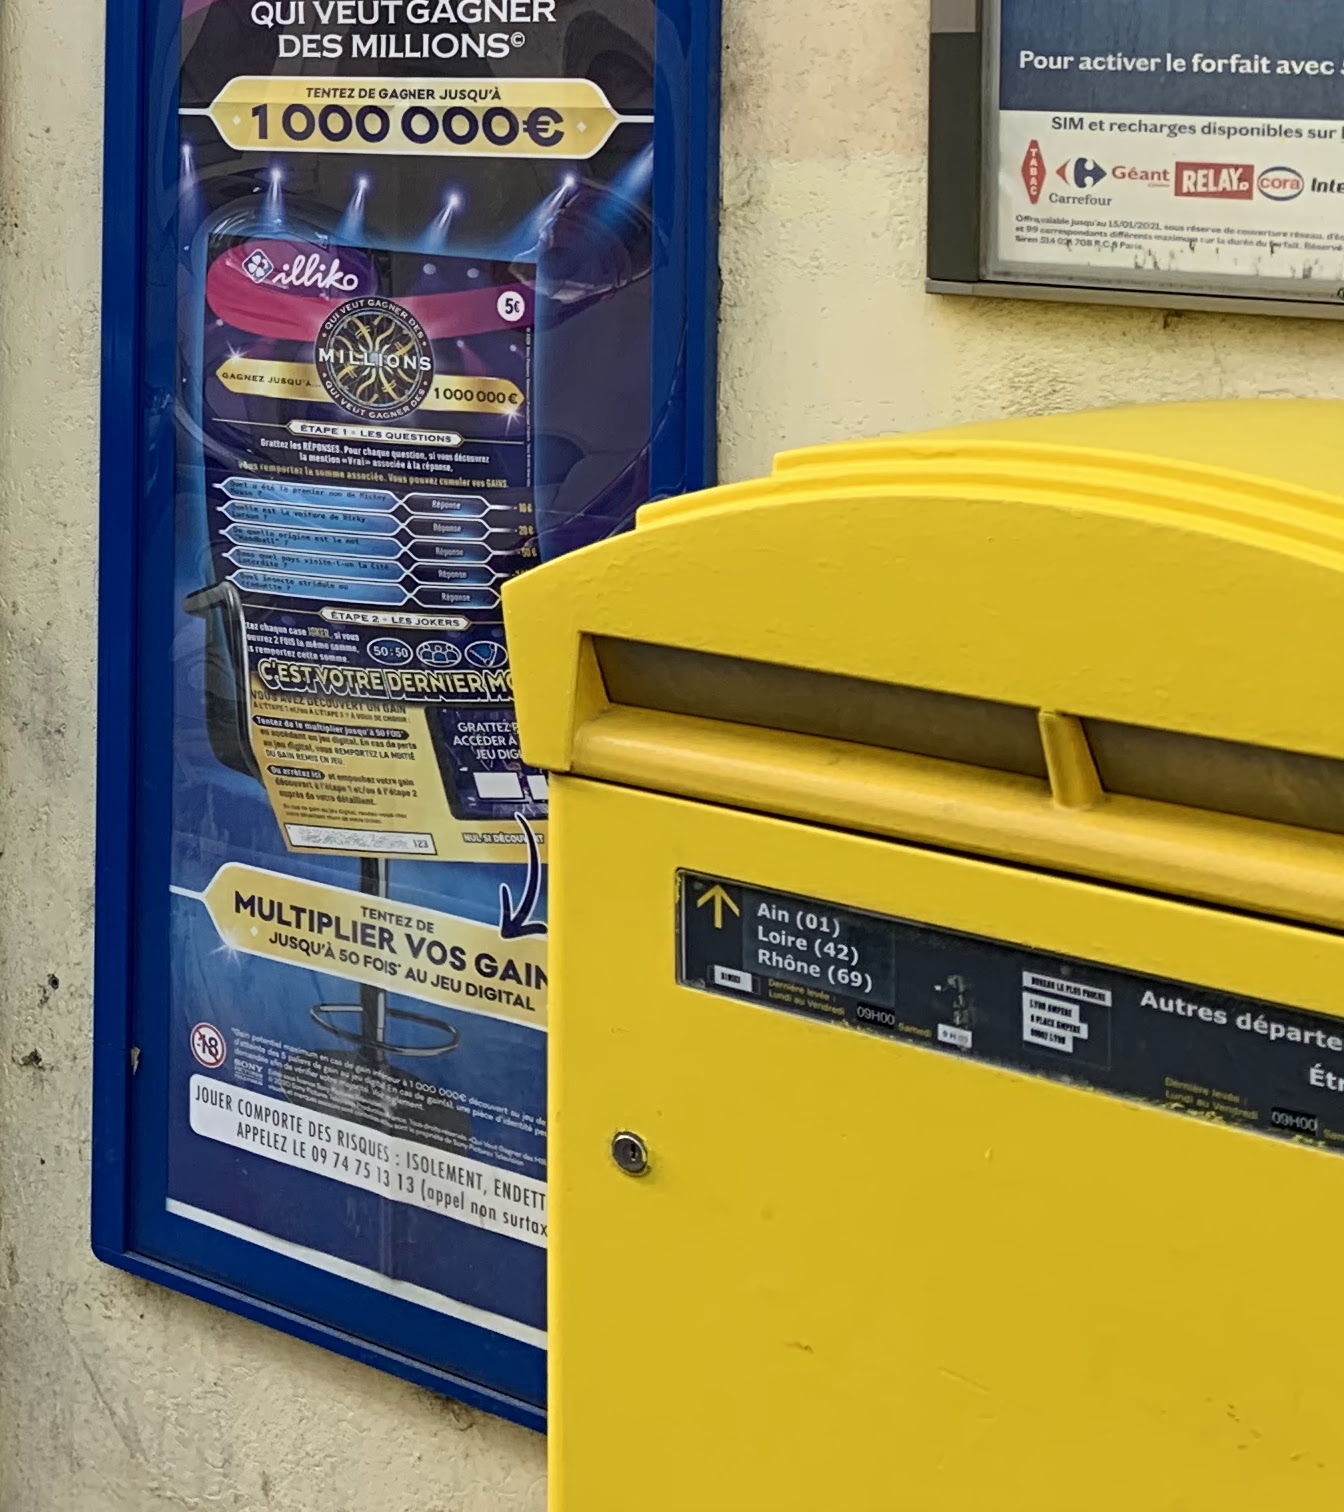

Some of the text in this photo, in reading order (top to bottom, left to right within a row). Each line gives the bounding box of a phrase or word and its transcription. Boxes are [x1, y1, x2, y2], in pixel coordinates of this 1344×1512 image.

[250, 0, 305, 29] QUI
[313, 0, 404, 25] VEUT
[278, 33, 344, 59] DES
[1019, 50, 1335, 76] Pour activer le forfait avec
[306, 86, 502, 102] TENTEZ DE GAGNER JUSQU'À
[1051, 116, 1337, 139] SIM et recharges disponibles sur
[1029, 148, 1038, 195] TABAC
[1112, 165, 1170, 182] Géant
[1181, 168, 1243, 193] RELAY
[1261, 177, 1300, 190] cora
[1048, 192, 1112, 206] Carrefour
[272, 253, 521, 315] illiko 5€
[324, 299, 424, 340] QUI VEUT GAGNER DES
[318, 347, 433, 371] MILLIONS
[324, 379, 427, 420] QUI VEUT GAGNER DES
[300, 424, 452, 443] ÉTAPE LES QUESTIONS
[260, 438, 390, 459] Grattez Pour chaque
[299, 452, 421, 470] la mention associée la
[260, 623, 307, 636] chaque case
[331, 610, 460, 627] ÉTAPE 2 LES JOKERS
[261, 660, 312, 684] C'EST
[315, 666, 384, 689] VOTRE
[388, 671, 483, 694] DERNIER
[453, 733, 506, 746] ACCÉDER
[457, 721, 511, 733] GRATTEZ
[476, 748, 496, 760] JEU
[233, 890, 397, 954] MULTIPLIER
[406, 934, 467, 972] VOS
[361, 905, 435, 934] TENTEZ DE
[757, 902, 841, 938] Ain (01)
[757, 925, 859, 966] Loire (42)
[268, 930, 336, 960] JUSQU'À
[339, 948, 360, 966] 50
[405, 966, 427, 984] AU
[430, 972, 462, 993] JEU
[465, 981, 536, 1011] DIGITAL
[758, 949, 821, 978] Rhône
[827, 966, 873, 994] (69)
[768, 990, 792, 1003] Lundi
[1140, 990, 1228, 1025] Autres
[857, 1006, 932, 1038] 09H00 Samedi
[234, 1058, 263, 1072] SONY
[1271, 1110, 1318, 1132] 09H00
[195, 1085, 233, 1112] JOUER
[238, 1098, 303, 1136] COMPORTE
[308, 1119, 332, 1144] DES
[337, 1128, 390, 1163] RISQUES
[406, 1153, 487, 1196] ISOLEMENT,
[236, 1122, 287, 1152] APPELEZ
[293, 1138, 306, 1160] LE
[311, 1144, 328, 1167] 09
[333, 1150, 350, 1173] 74
[354, 1157, 371, 1179] 75
[376, 1165, 390, 1187] 13
[397, 1173, 415, 1194] 13
[420, 1178, 465, 1212] (appel
[471, 1201, 497, 1221] non
